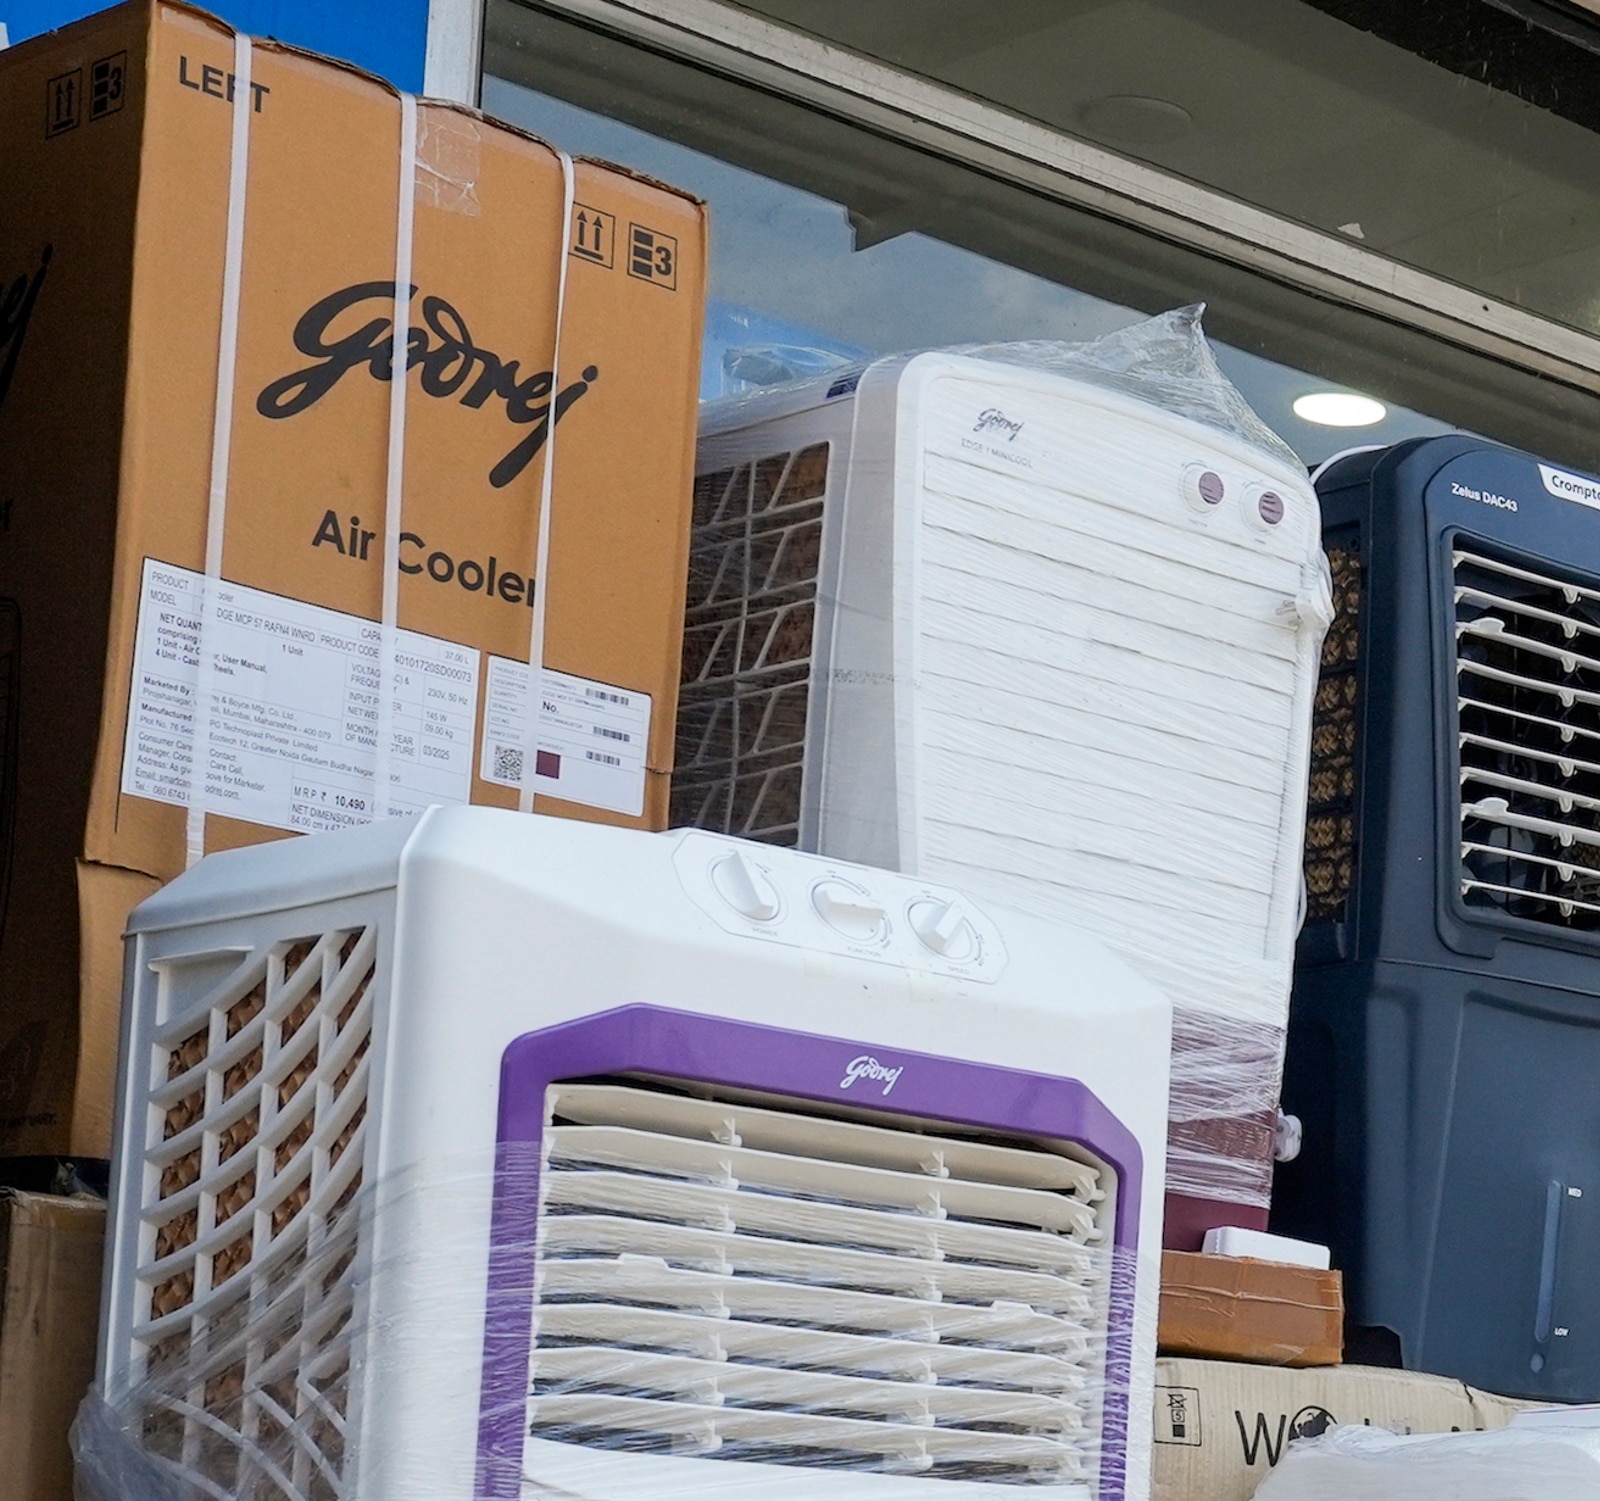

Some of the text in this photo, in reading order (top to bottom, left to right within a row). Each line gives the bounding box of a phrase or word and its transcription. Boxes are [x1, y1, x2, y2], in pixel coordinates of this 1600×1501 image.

[257, 282, 598, 488] Godrej
[1451, 482, 1518, 512] Zelus DAC43
[312, 509, 377, 562] Air
[152, 570, 190, 591] PRODUCT
[150, 589, 177, 606] MODEL
[320, 634, 357, 653] PRODUCT
[358, 645, 380, 659] CODE
[159, 612, 175, 626] NET
[144, 676, 178, 694] Marketed
[141, 702, 192, 722] Manufactured
[840, 1055, 904, 1096] Godrej
